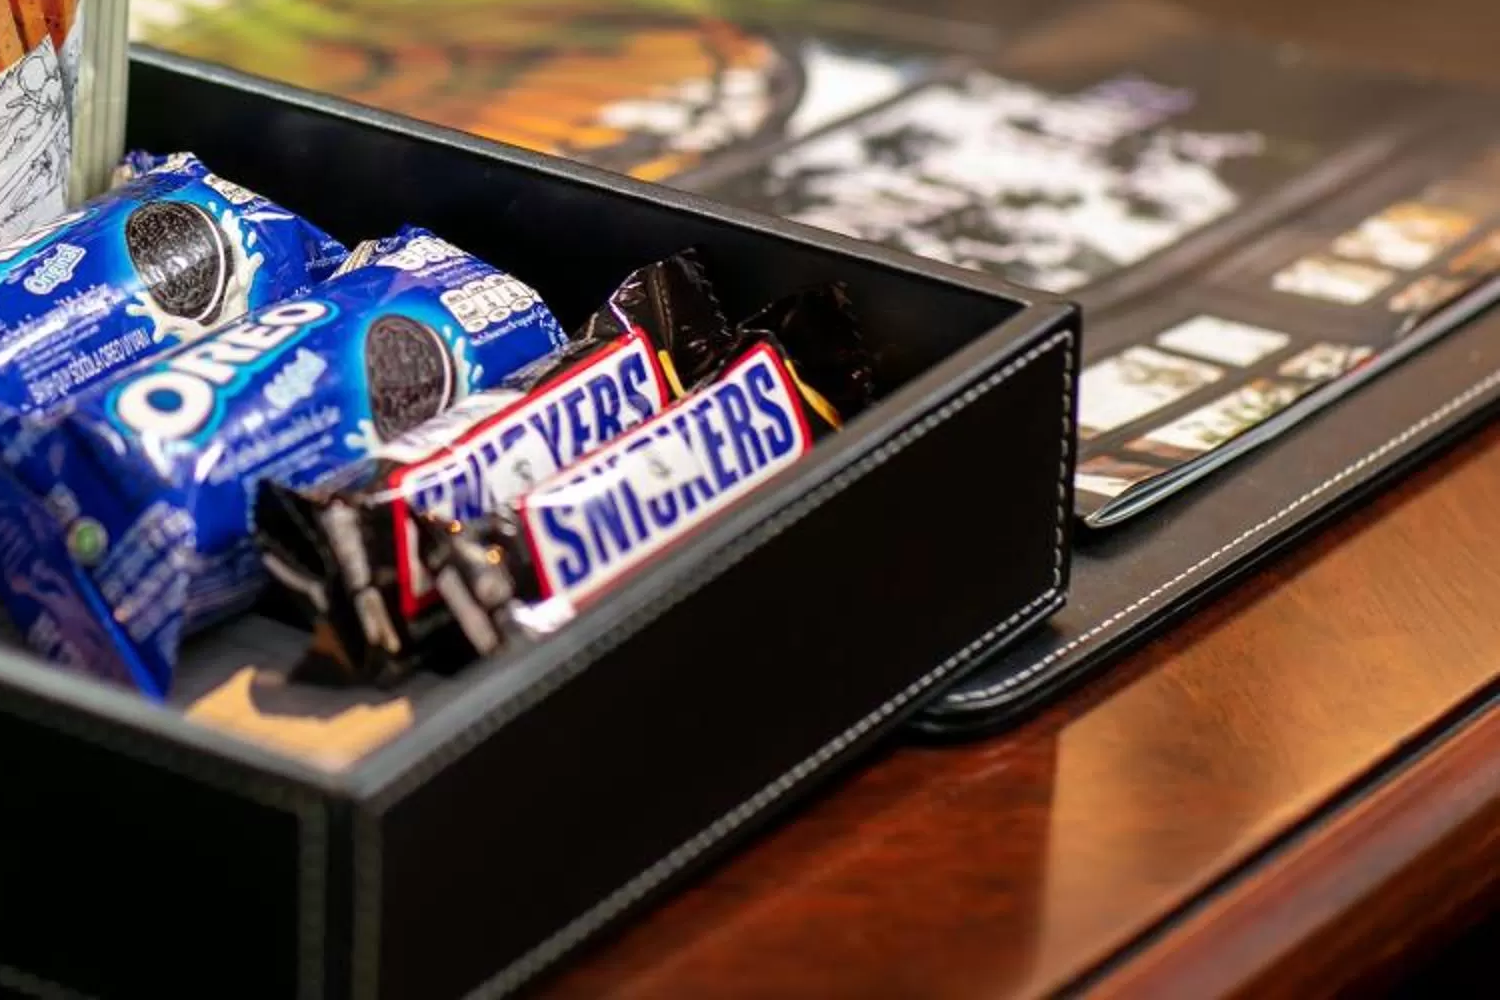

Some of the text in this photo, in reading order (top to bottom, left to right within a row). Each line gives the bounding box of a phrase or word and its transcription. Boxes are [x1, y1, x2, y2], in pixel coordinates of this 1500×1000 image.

[112, 299, 332, 442] OREO
[411, 351, 655, 522] NKERS
[540, 361, 795, 588] SNICKERS
